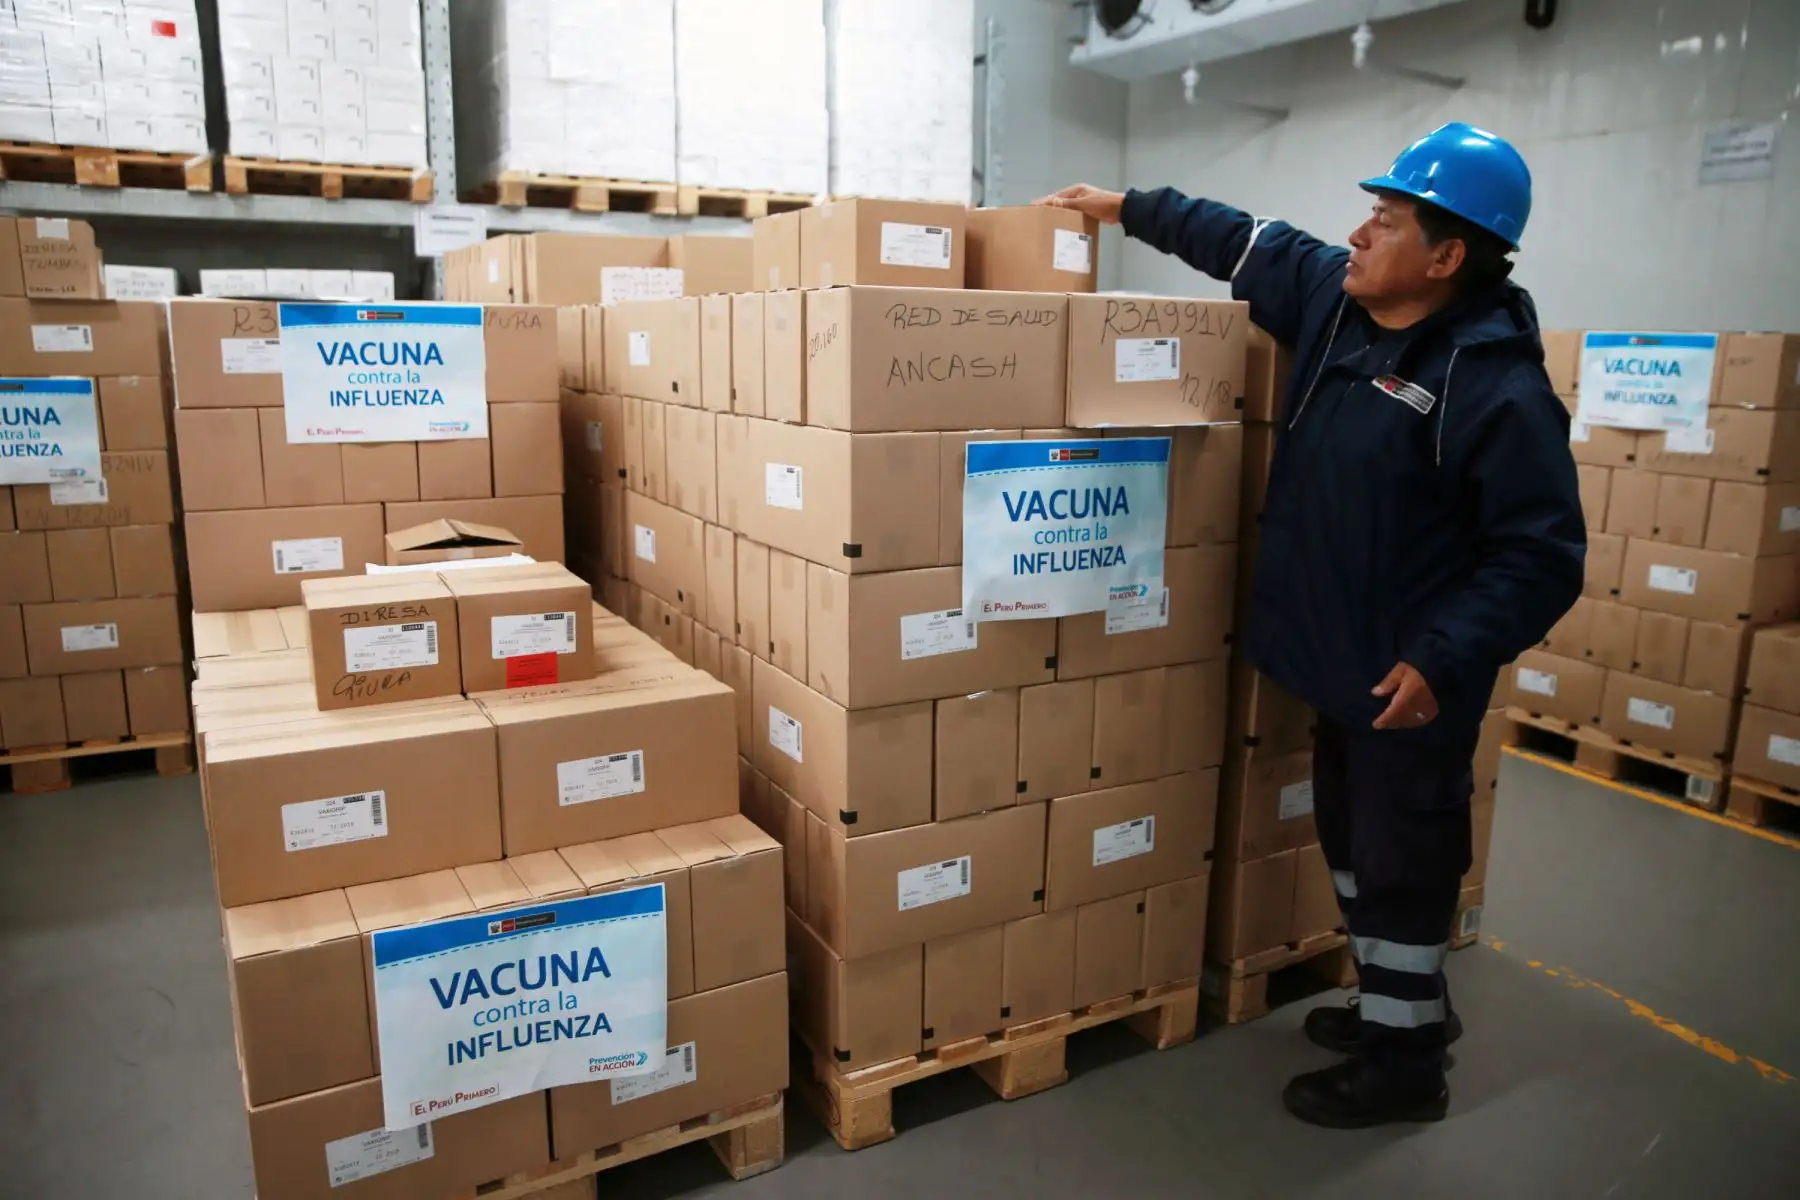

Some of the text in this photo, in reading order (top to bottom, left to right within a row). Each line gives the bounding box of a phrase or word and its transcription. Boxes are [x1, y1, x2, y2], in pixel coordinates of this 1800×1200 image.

[885, 303, 1059, 330] RED DE SALUD
[1101, 299, 1234, 346] R3A991V
[317, 341, 444, 366] VACUNA
[347, 368, 421, 385] contra la
[886, 351, 1018, 389] ANCASH
[1604, 357, 1682, 377] VACUNA
[329, 388, 445, 408] INFLUENZA
[1604, 390, 1678, 406] INFLUENZA
[0, 406, 62, 427] UNA
[29, 428, 41, 441] la
[0, 443, 64, 458] UENZA
[1002, 486, 1130, 522] VACUNA
[1034, 521, 1108, 545] contra la
[1013, 544, 1127, 576] INFLUENZA
[339, 604, 430, 625] DIRESA
[430, 946, 612, 1010] VACUNA
[473, 991, 578, 1028] contra la
[448, 1012, 613, 1066] INFLUENZA
[588, 1052, 635, 1065] Prevención
[589, 1064, 601, 1073] EN
